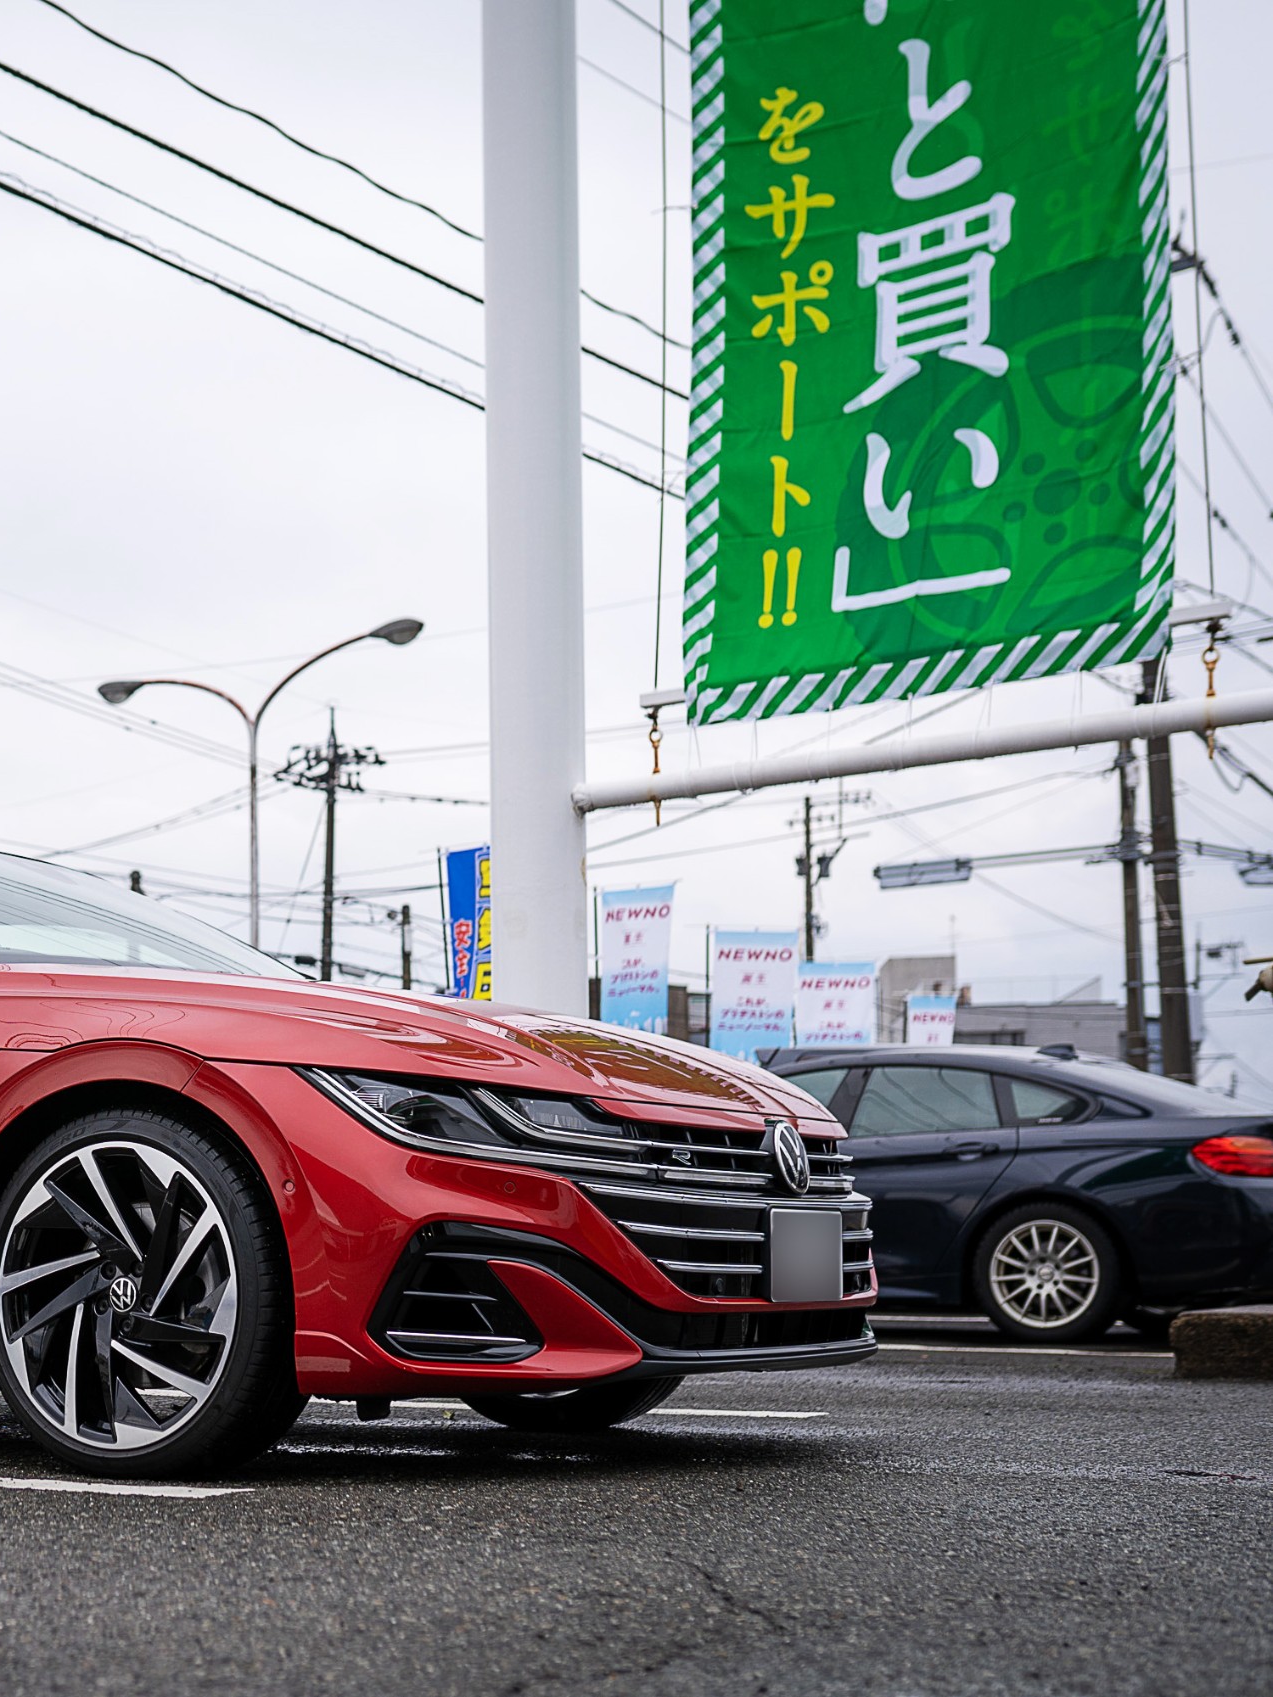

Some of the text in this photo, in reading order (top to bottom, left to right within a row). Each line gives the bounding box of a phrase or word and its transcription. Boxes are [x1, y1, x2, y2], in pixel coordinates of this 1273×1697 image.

[833, 0, 1015, 611] と買い」
[605, 904, 671, 923] NEWNO
[717, 948, 793, 962] NEWNO
[800, 976, 871, 991] NEWNO
